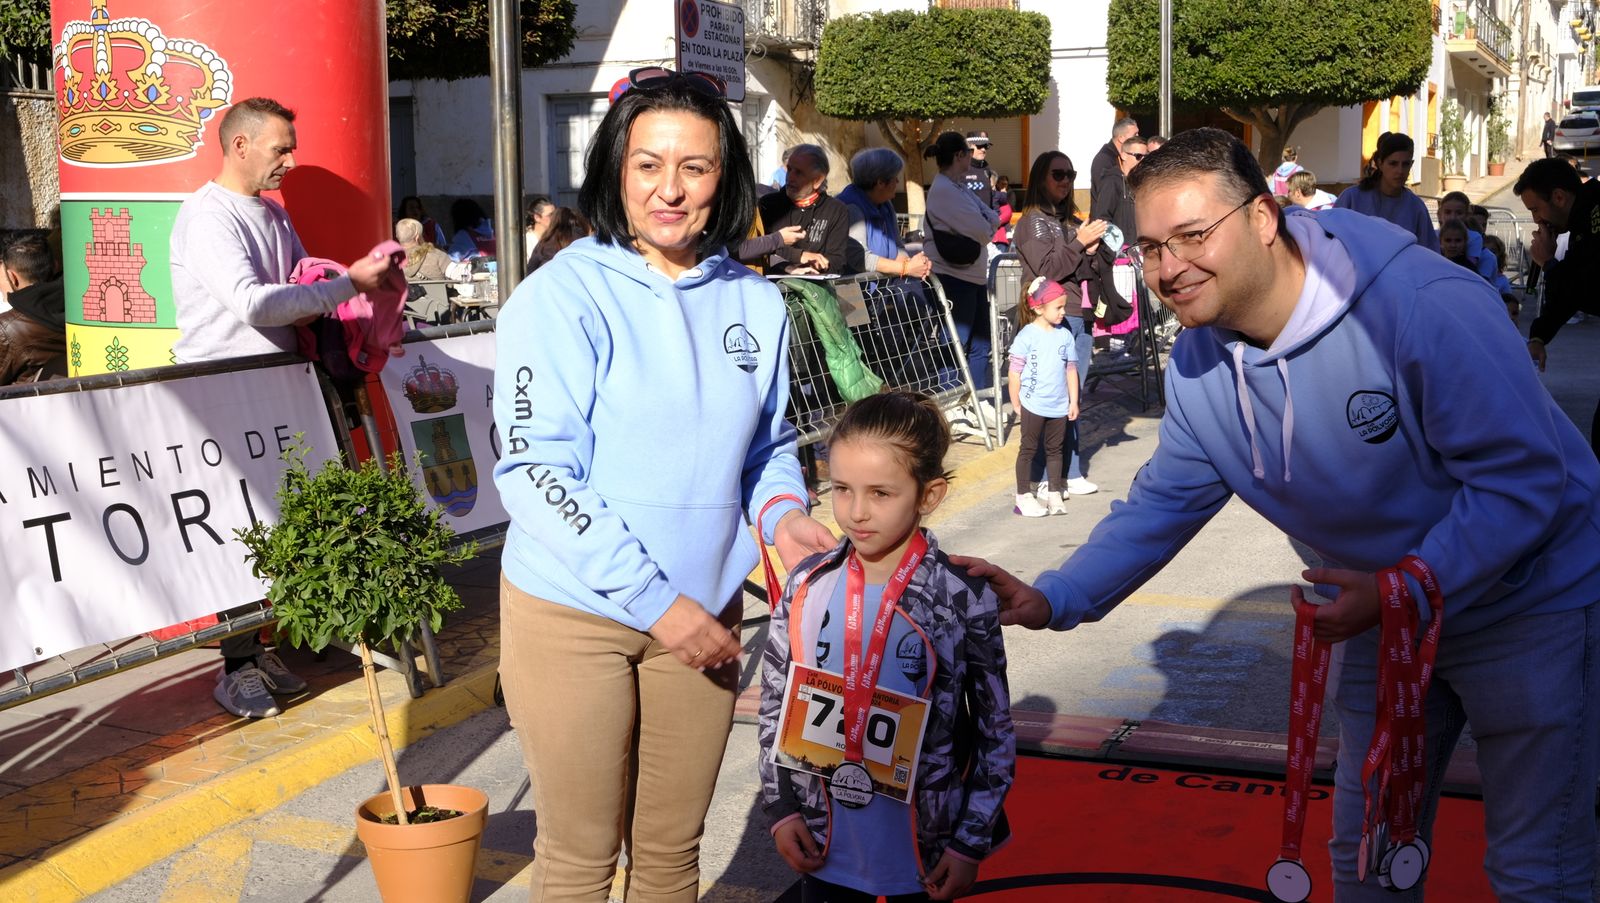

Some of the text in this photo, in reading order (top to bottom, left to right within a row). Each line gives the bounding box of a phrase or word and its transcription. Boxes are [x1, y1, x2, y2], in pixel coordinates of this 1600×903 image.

[701, 3, 743, 24] PROHIBIDO
[710, 21, 735, 33] PARAR Y
[704, 30, 740, 46] ESTACIONAR
[681, 41, 744, 62] EN TODA LA PLAZA
[0, 425, 292, 503] MIENTO DE
[525, 464, 593, 536] LVORA
[22, 478, 261, 583] TORI
[806, 677, 816, 686] LA
[817, 679, 845, 696] POLVO
[812, 693, 897, 749] 70
[1098, 767, 1157, 784] de
